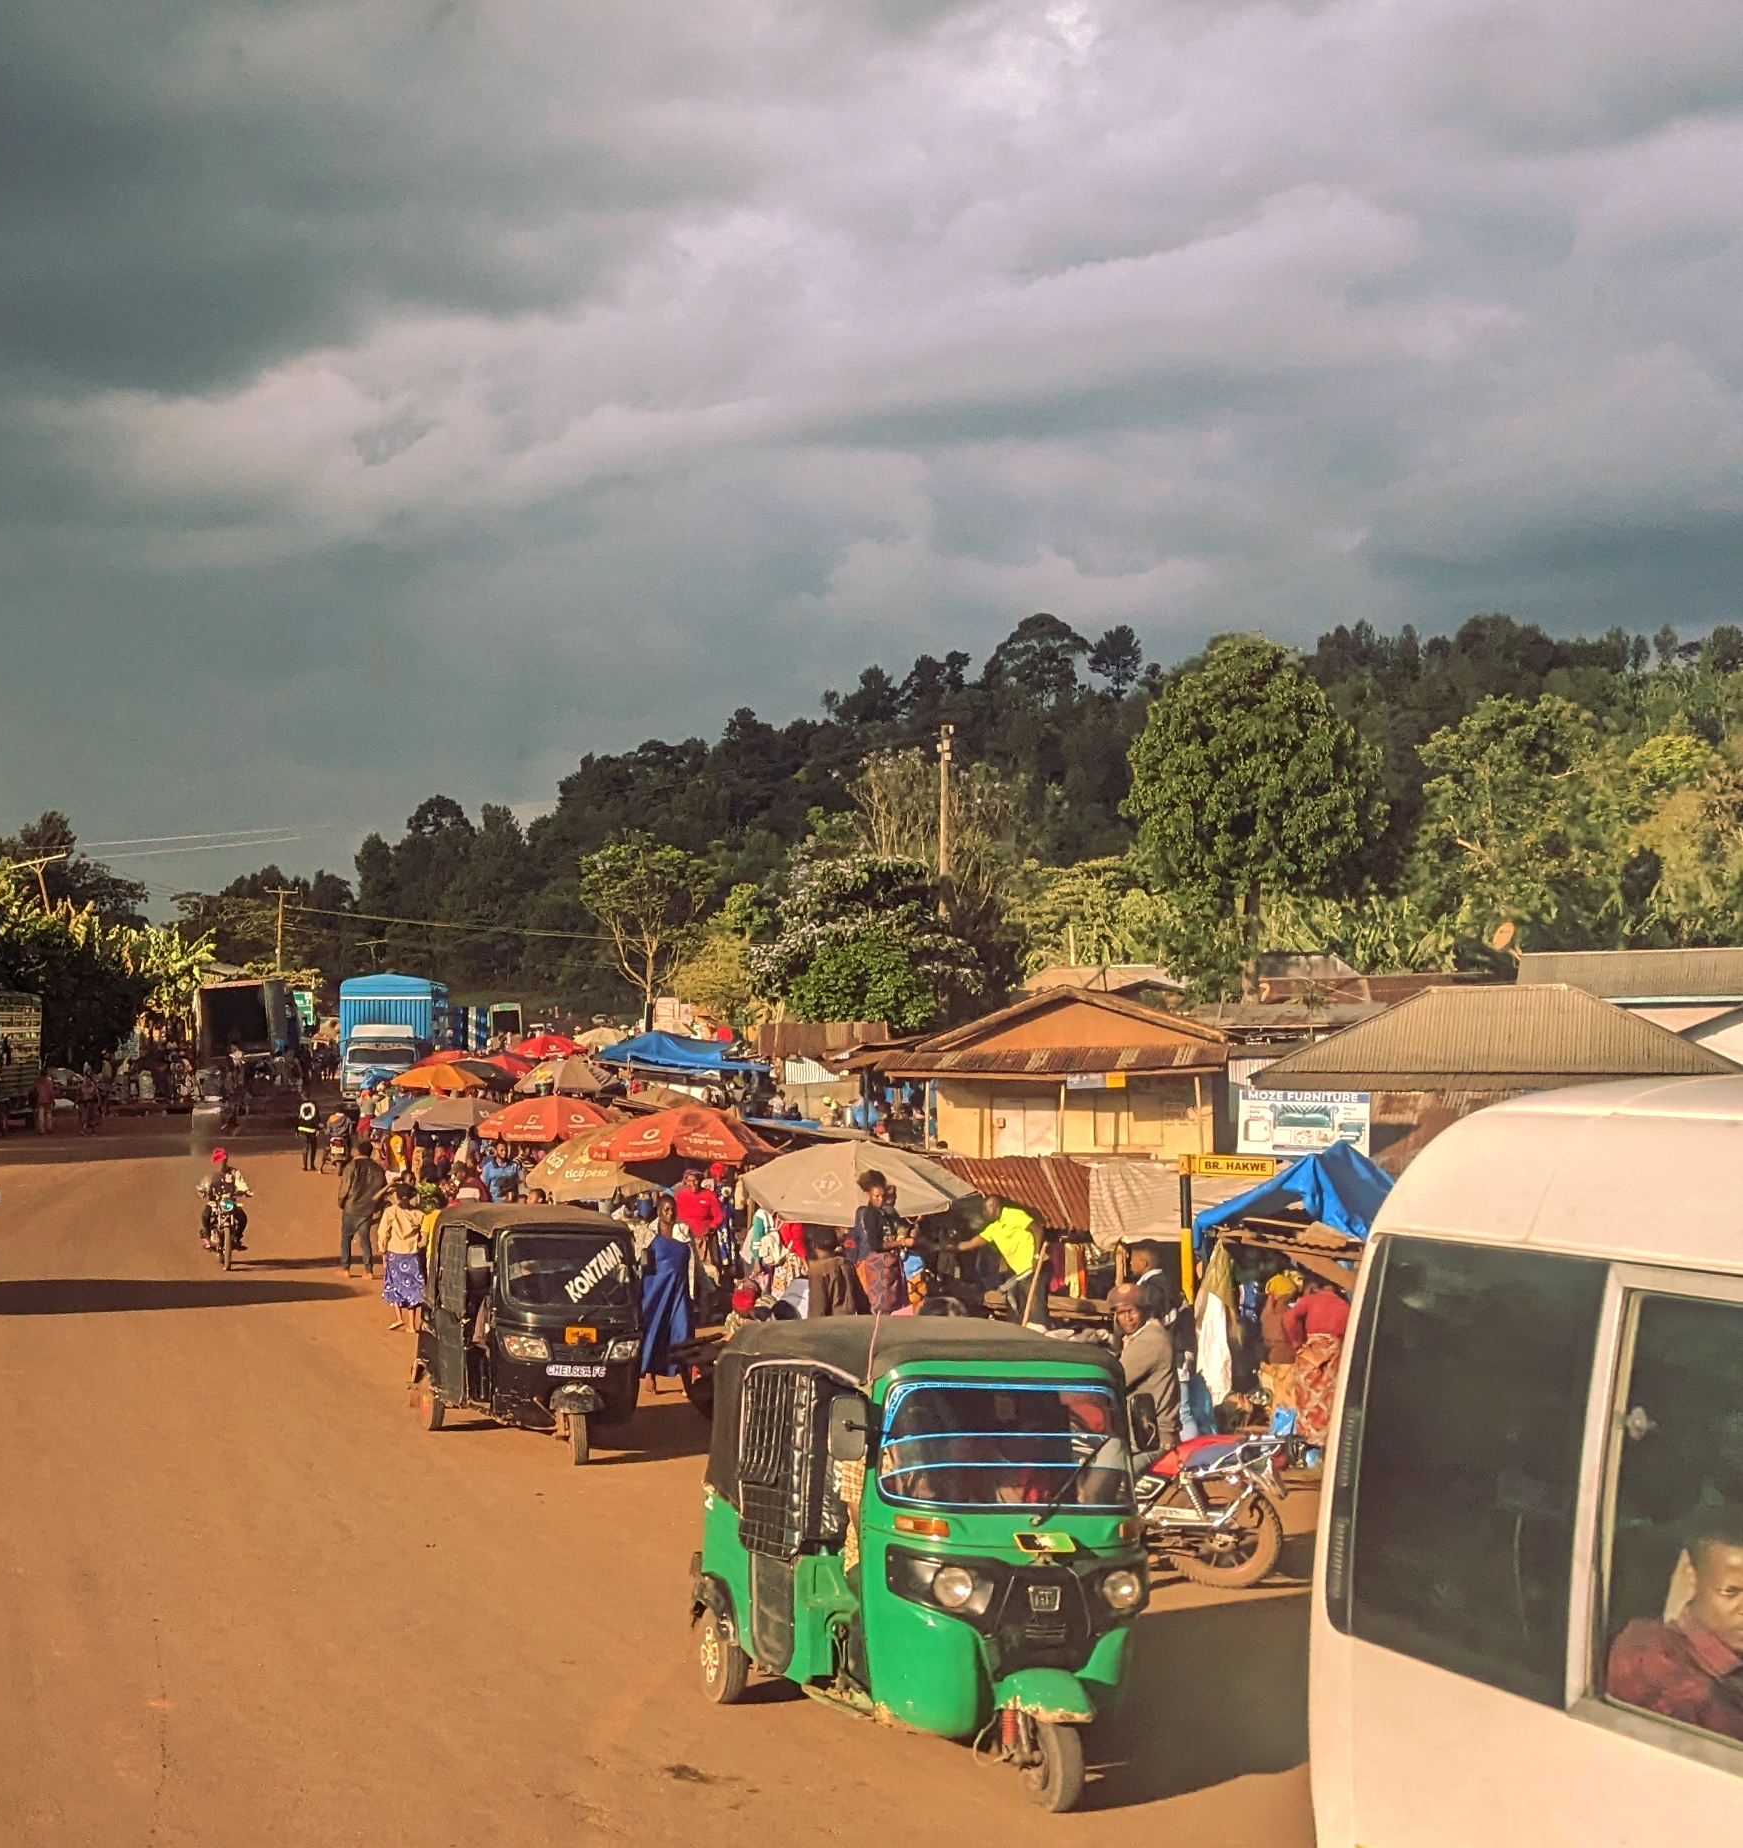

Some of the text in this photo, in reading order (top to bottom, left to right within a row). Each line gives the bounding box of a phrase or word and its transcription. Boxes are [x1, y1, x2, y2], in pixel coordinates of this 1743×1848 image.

[1248, 1091, 1359, 1102] MOZE FURNITURE
[1204, 1161, 1267, 1172] BR. HAKWE
[585, 1169, 609, 1178] pesa
[564, 1242, 624, 1304] KONTAWA
[546, 1364, 606, 1377] CHELSEA FC
